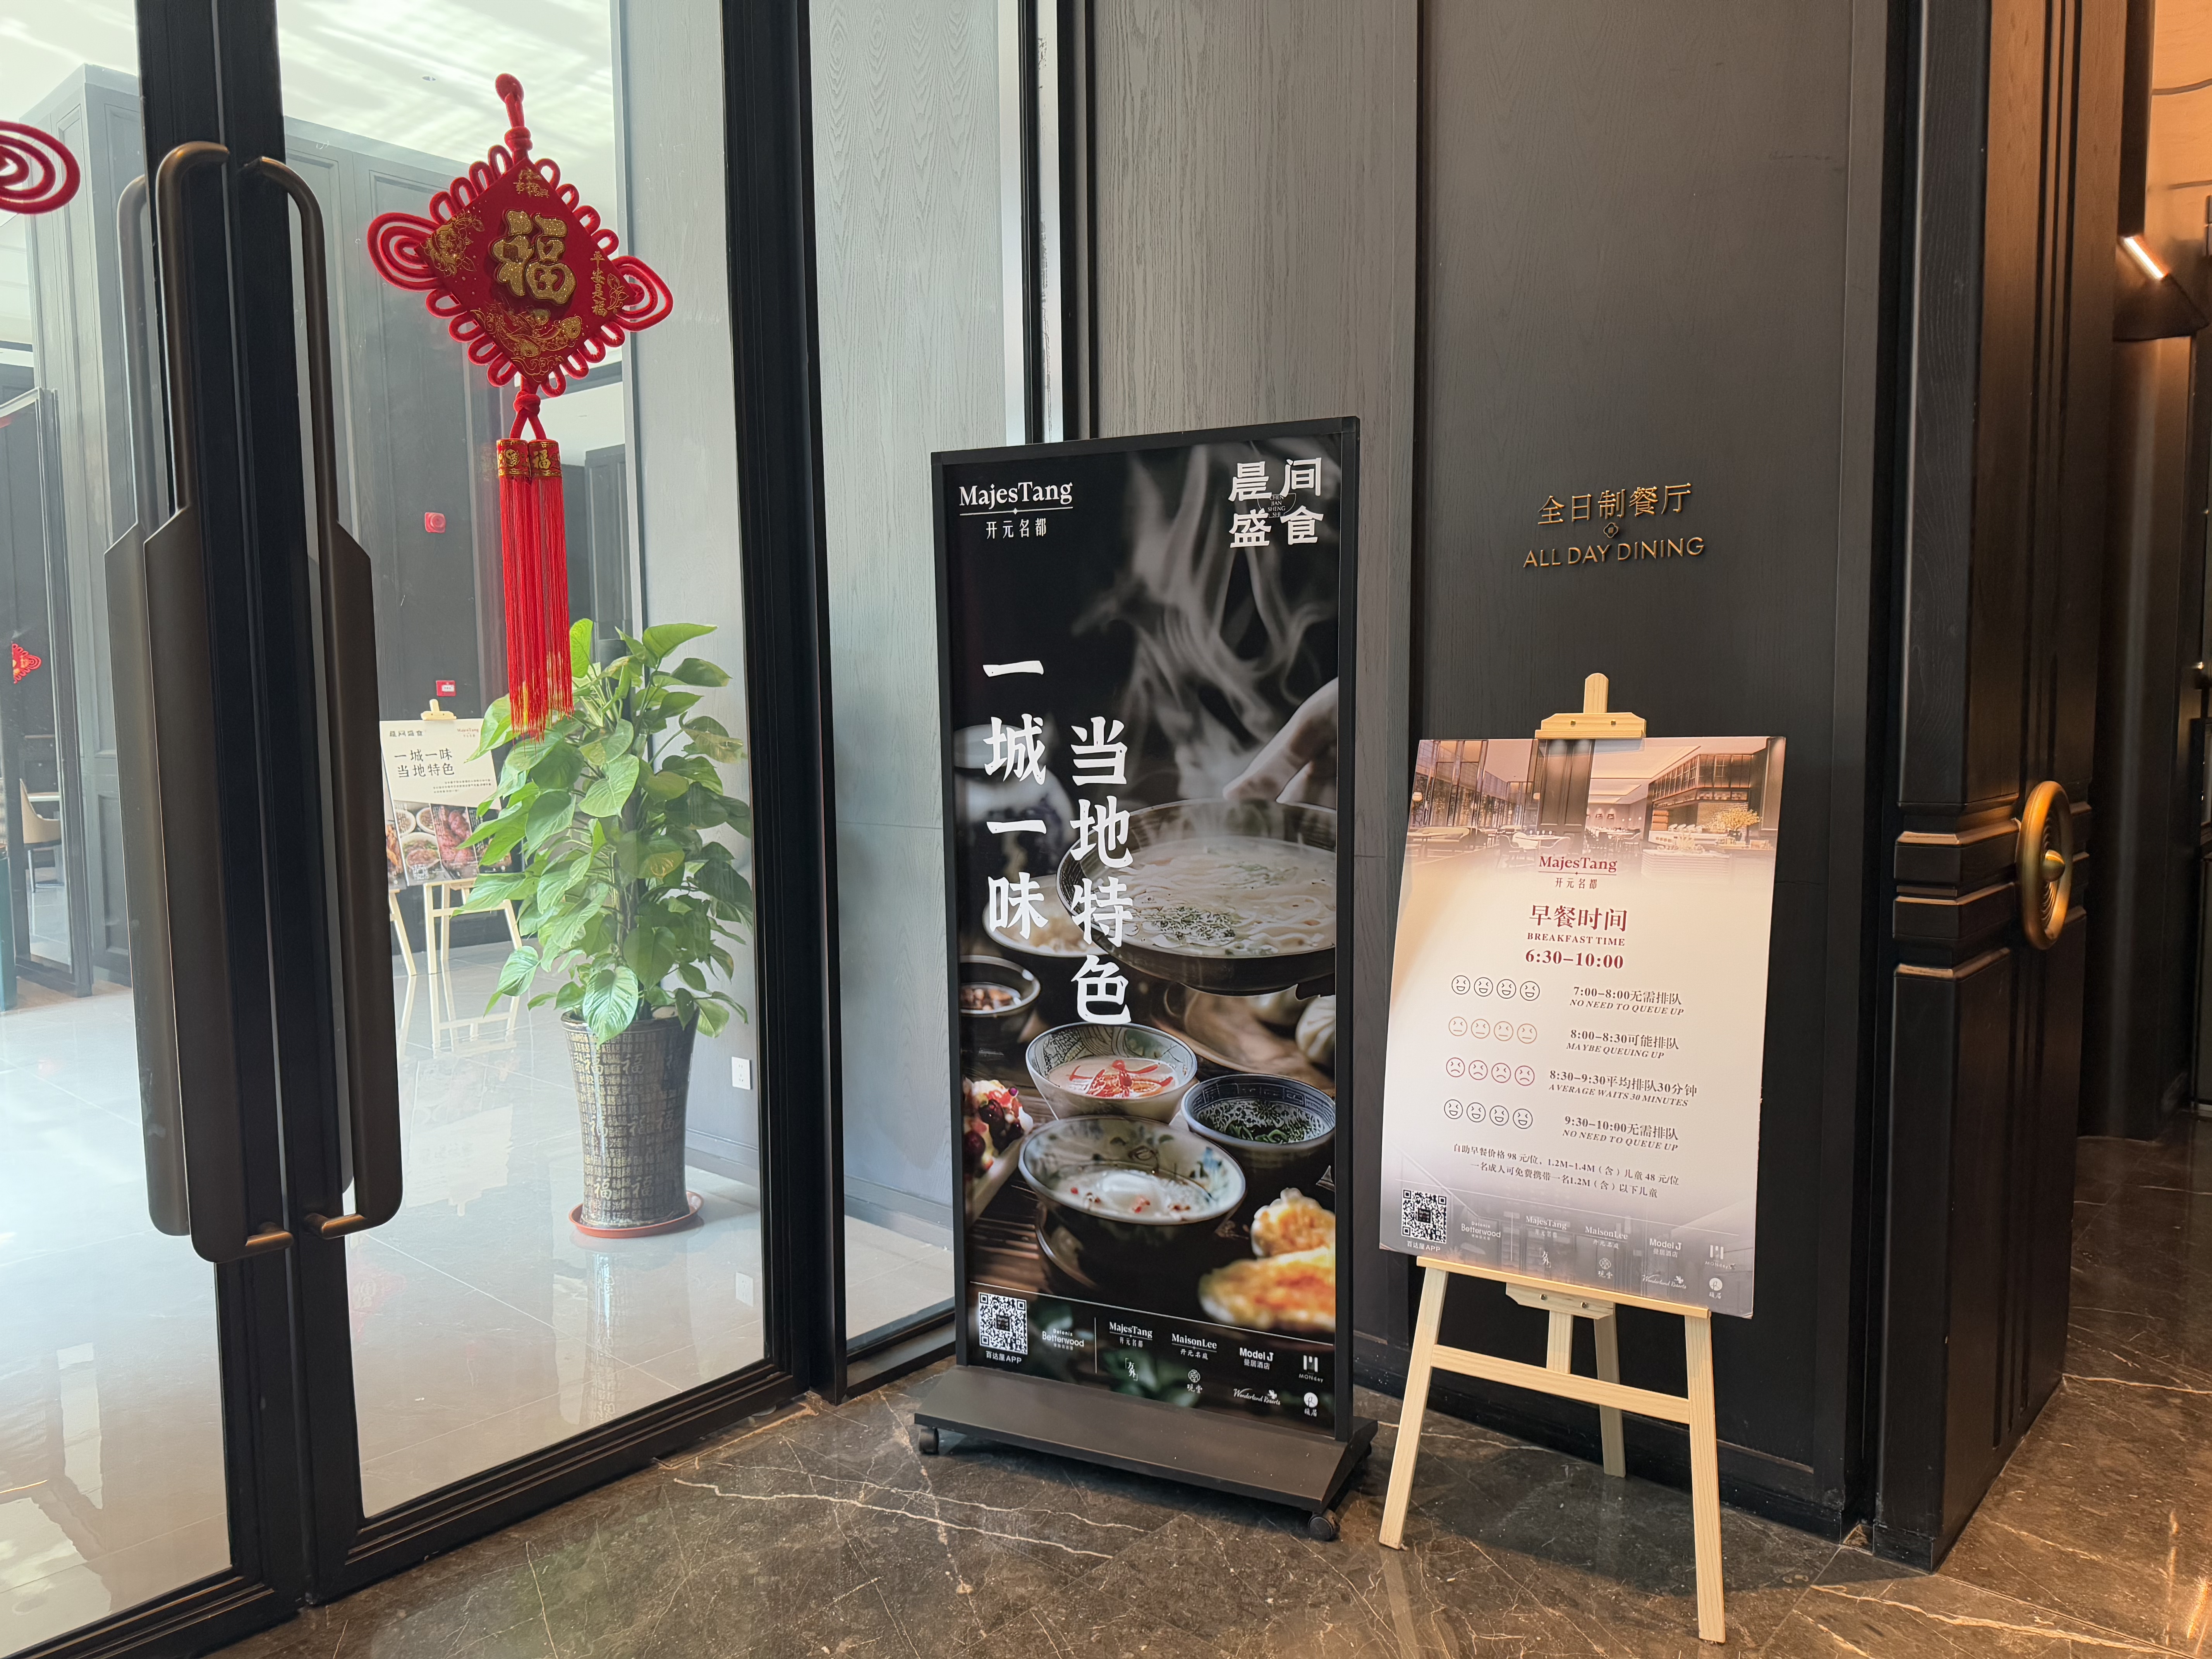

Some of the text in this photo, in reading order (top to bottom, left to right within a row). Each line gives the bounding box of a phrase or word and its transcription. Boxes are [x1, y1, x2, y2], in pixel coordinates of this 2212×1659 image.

[490, 210, 577, 304] 福
[590, 251, 608, 317] 平安是福
[959, 482, 1073, 510] MajesTang
[1538, 483, 1691, 524] 全日制餐厅
[986, 518, 1046, 539] 开元名都
[1523, 537, 1704, 568] ALL DAY DINING
[394, 748, 452, 762] 一城一味
[398, 763, 454, 778] 当地特色
[983, 660, 1048, 940] 一城一味
[1070, 716, 1133, 1025] 当地特色
[1539, 856, 1617, 872] MajesTang
[1555, 878, 1597, 889] 开元名都
[1529, 905, 1627, 932] 早餐时间
[1527, 933, 1625, 946] BREAKFAST TIME
[1526, 949, 1623, 969] 6:30-10:00
[1586, 1001, 1613, 1009] NEED
[1632, 1005, 1668, 1014] QUEUE
[1566, 1043, 1601, 1052] MAYBE
[1603, 1047, 1649, 1058] QUEUING
[1549, 1084, 1595, 1095] AVERAGE
[1598, 1089, 1629, 1099] WAITS
[1642, 1095, 1688, 1106] MINUTES
[1579, 1132, 1606, 1141] NEED
[1625, 1139, 1662, 1149] QUEUE
[594, 1177, 612, 1200] 福
[1461, 1223, 1501, 1238] Betterwood
[1526, 1216, 1567, 1230] MajesTang
[1585, 1226, 1628, 1240] MaisonLee
[1649, 1238, 1681, 1250] Model J
[1109, 1321, 1152, 1339] MajesTang
[1042, 1331, 1084, 1347] Betterwood
[1172, 1333, 1217, 1349] MaisonLee
[1240, 1347, 1274, 1362] Model J
[1233, 1388, 1262, 1402] Wonderland
